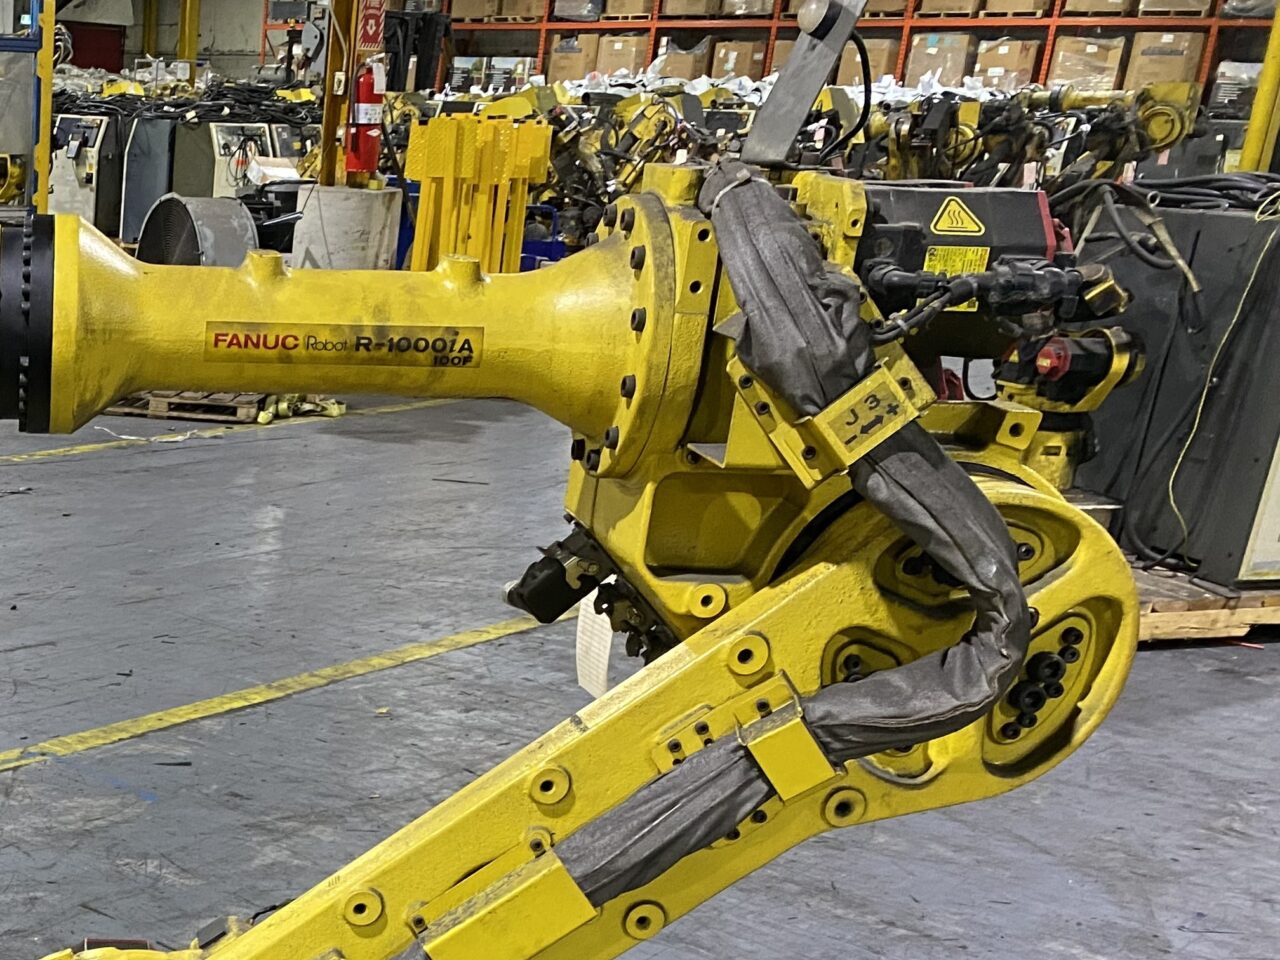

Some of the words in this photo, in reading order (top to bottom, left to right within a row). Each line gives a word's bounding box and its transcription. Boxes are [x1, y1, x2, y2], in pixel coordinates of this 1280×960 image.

[213, 332, 300, 351] FANUC
[306, 334, 349, 353] Robot
[353, 330, 474, 354] R-1000iA
[432, 354, 474, 367] 100F
